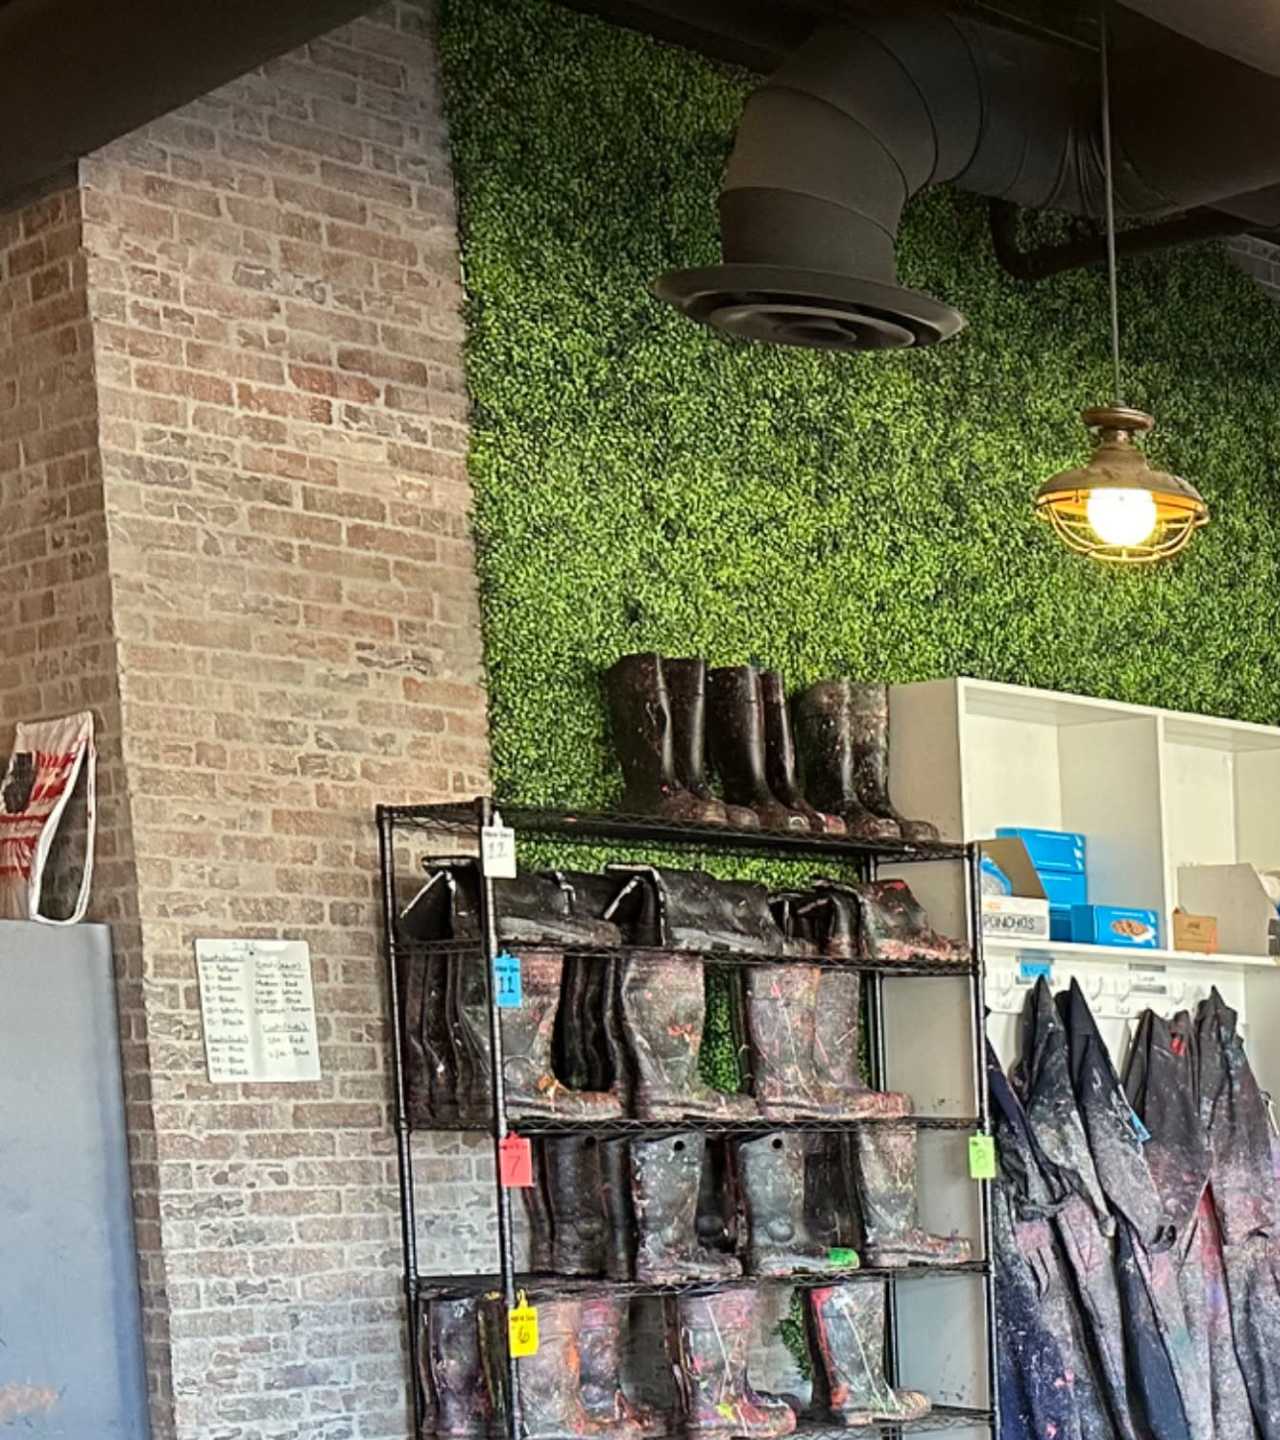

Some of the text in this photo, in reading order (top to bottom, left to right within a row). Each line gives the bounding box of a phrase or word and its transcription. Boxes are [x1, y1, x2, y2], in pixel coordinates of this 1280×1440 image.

[499, 975, 516, 994] 11
[507, 1155, 521, 1177] 7
[517, 1326, 530, 1345] 6
